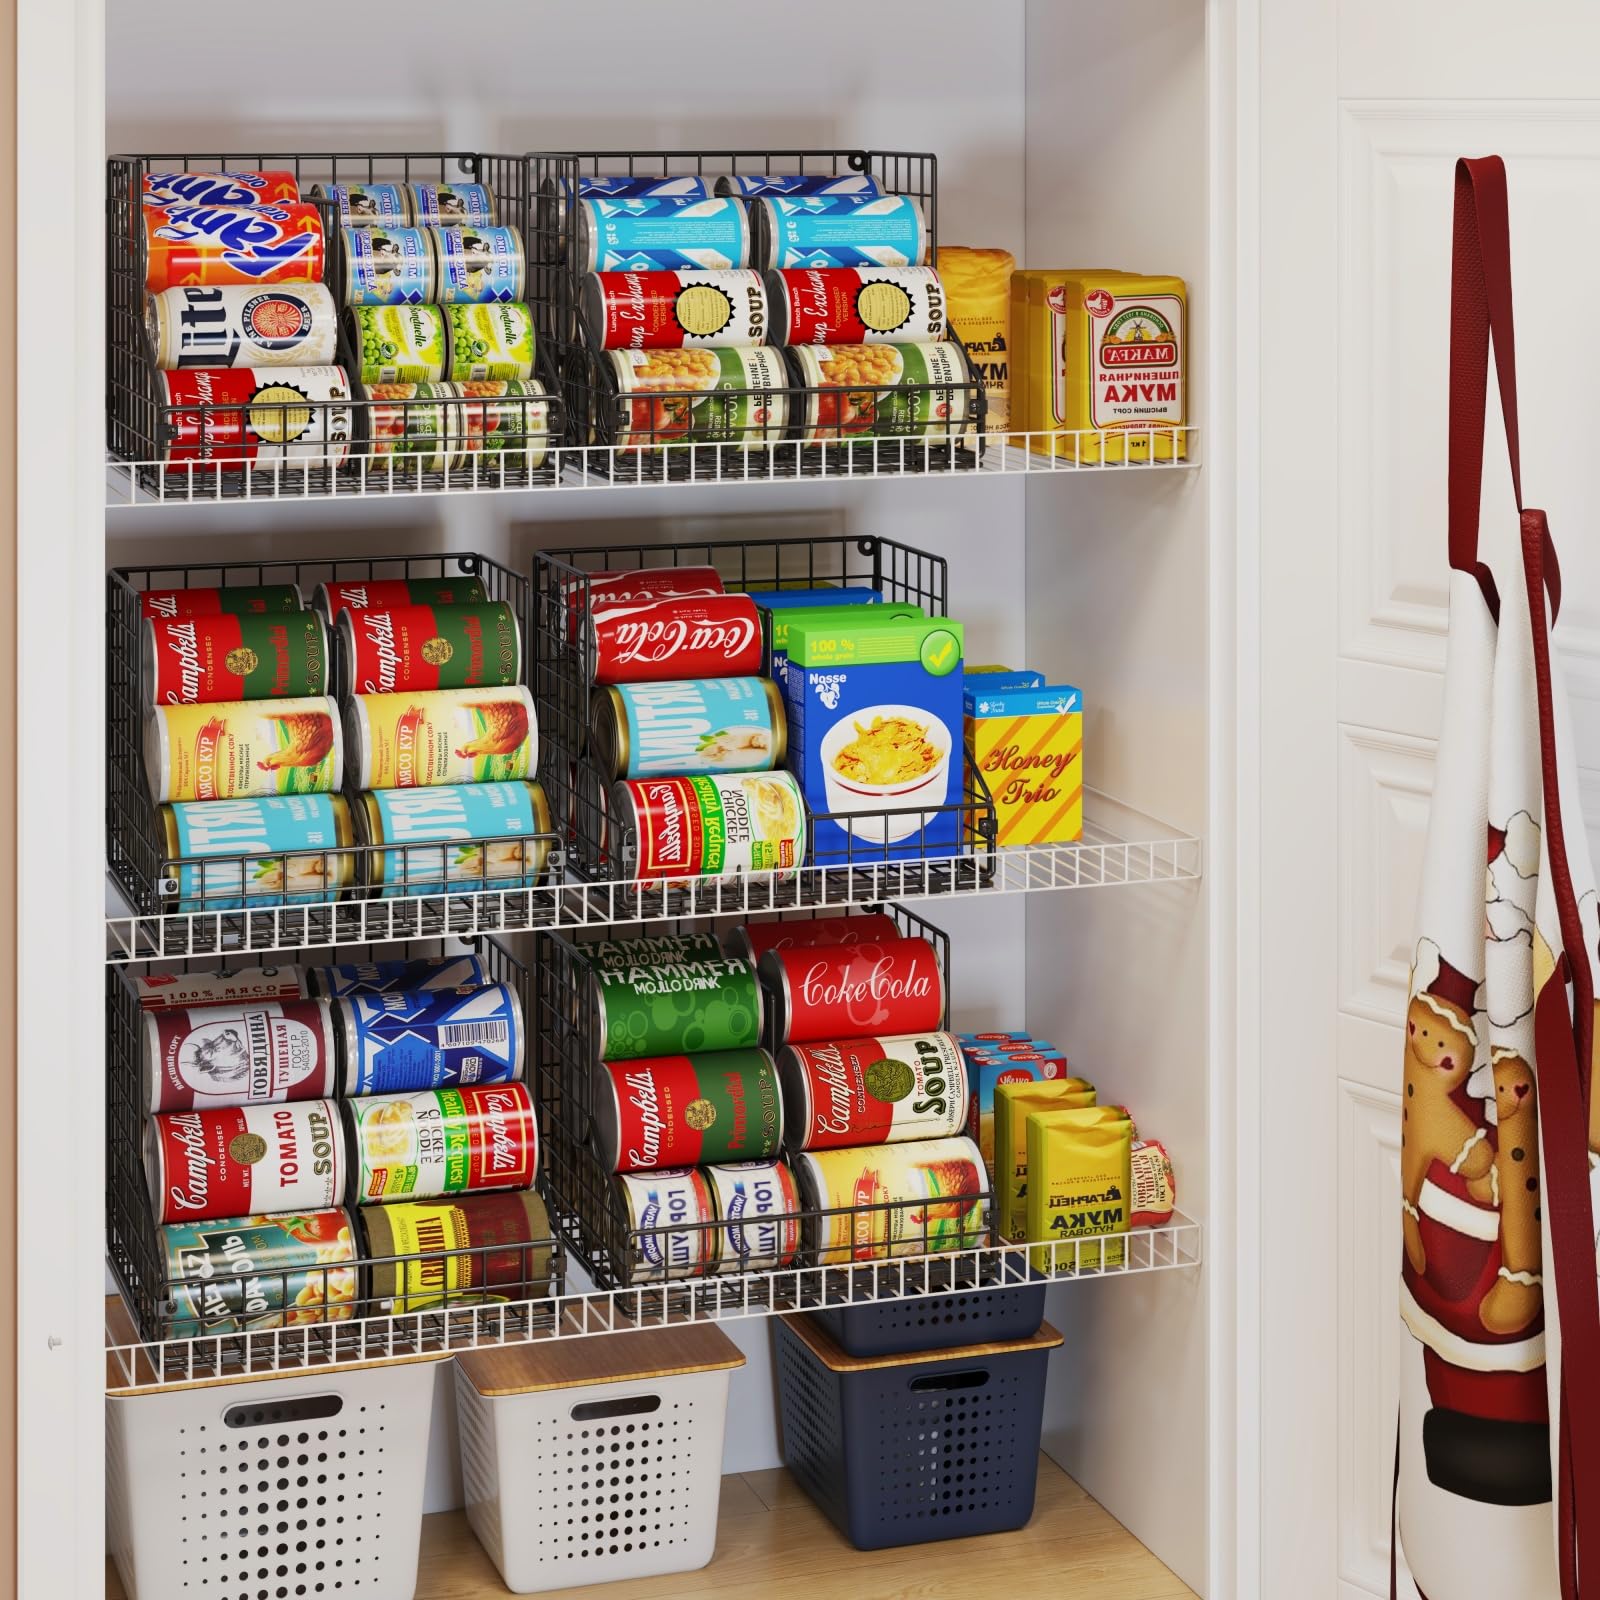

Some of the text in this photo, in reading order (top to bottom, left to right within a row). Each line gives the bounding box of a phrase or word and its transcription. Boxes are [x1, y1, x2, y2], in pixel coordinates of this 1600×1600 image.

[746, 286, 764, 339] SOUP
[833, 286, 842, 328] CONDENSED
[842, 291, 850, 322] VERSION
[926, 283, 944, 334] SOUP
[205, 634, 214, 691] CONDENSED
[303, 631, 321, 686] SOUP
[401, 625, 411, 681] CONDENSED
[495, 621, 514, 675] SOUP
[809, 638, 855, 652] 100 %
[809, 672, 847, 685] Nosse
[199, 736, 214, 762] КУР
[226, 732, 236, 753] СОКУ
[400, 725, 413, 751] КУР
[424, 721, 433, 741] СОКУ
[984, 745, 1077, 778] Honey
[1002, 778, 1062, 804] Trio
[168, 984, 277, 1001] 100% МЯСО
[165, 1035, 186, 1091] ВЫСШИЙ СОРТ
[249, 1012, 269, 1098] ГОВЯДИНА
[275, 1023, 290, 1085] ТУШЕНАЯ
[291, 1042, 302, 1072] ГОСТ
[912, 1040, 947, 1115] SOUP
[914, 1059, 924, 1097] TOMATO
[851, 1054, 868, 1114] CONDENSED
[946, 1065, 956, 1100] CAMPBELL
[663, 1086, 674, 1149] CONDENSED
[758, 1078, 776, 1139] SOUP
[946, 1100, 957, 1123] JOSEPH
[215, 1124, 228, 1182] CONDENSED
[272, 1110, 299, 1188] TOMATO
[308, 1111, 332, 1177] SOUP
[447, 1132, 465, 1185] Request
[1158, 1184, 1166, 1203] ГОСТ
